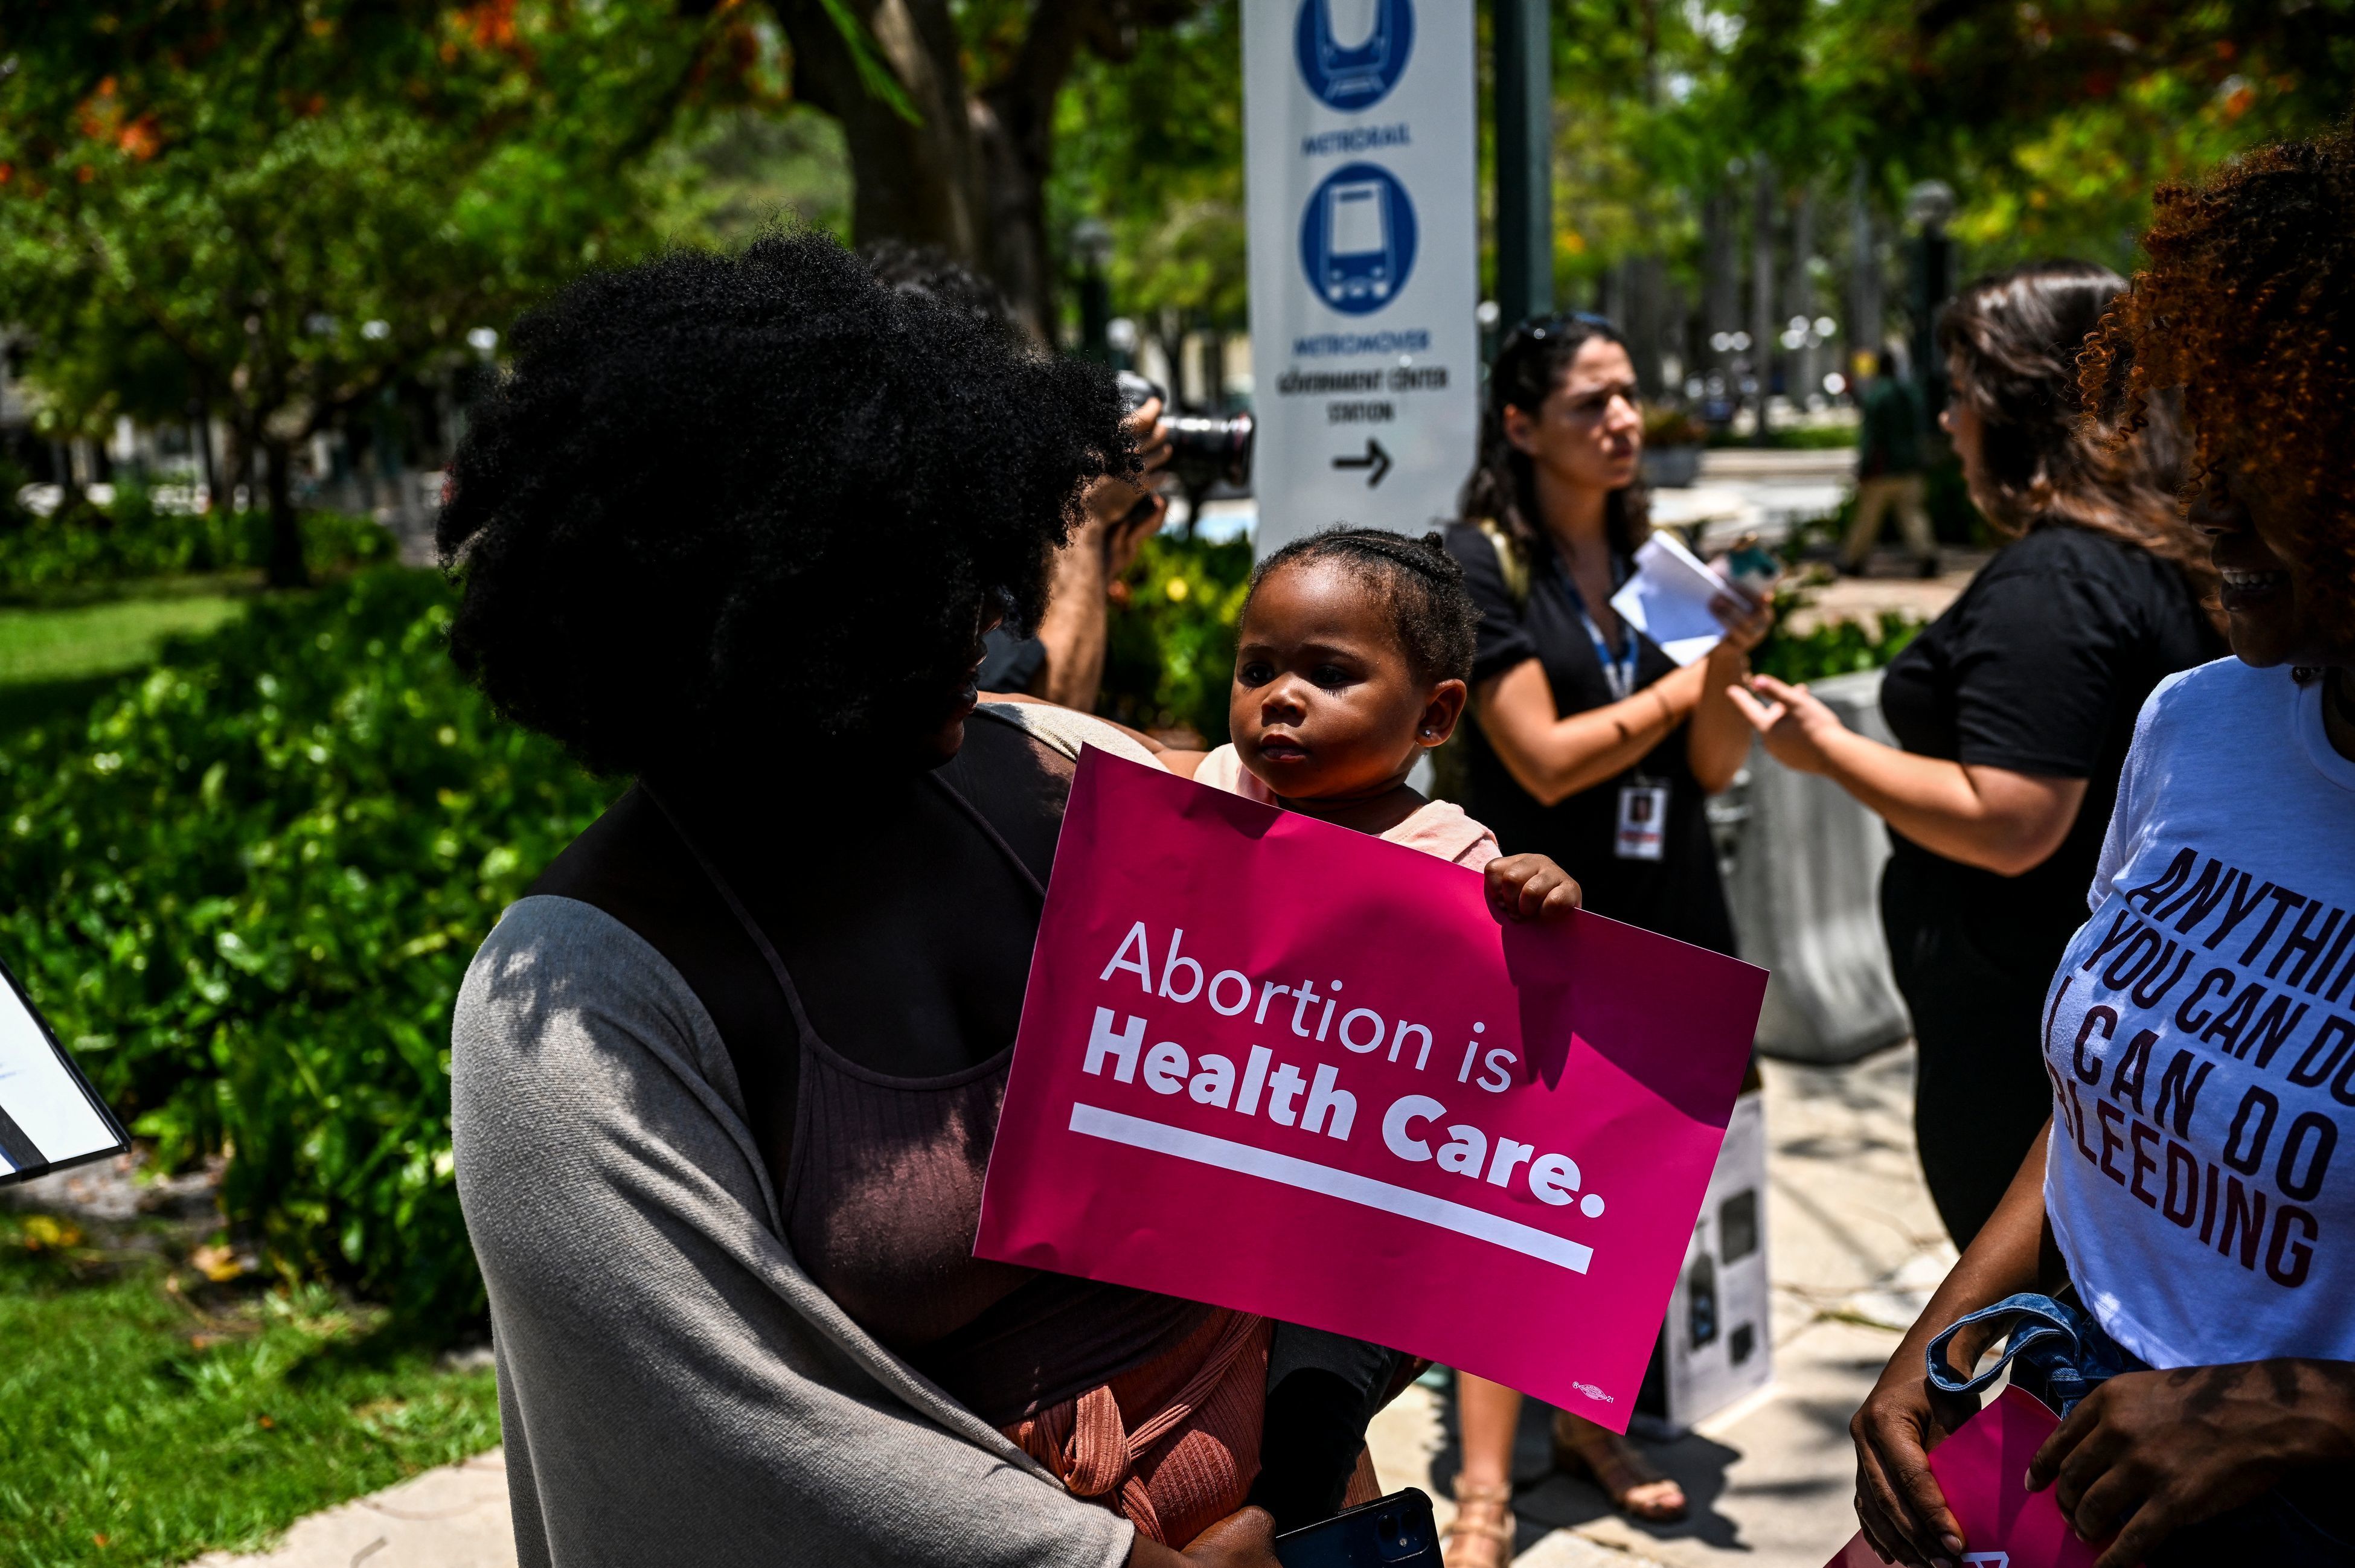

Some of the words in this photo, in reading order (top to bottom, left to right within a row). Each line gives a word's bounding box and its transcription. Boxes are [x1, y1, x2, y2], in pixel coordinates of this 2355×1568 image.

[1276, 371, 1381, 395] GOVERNMENT
[1389, 366, 1447, 391] CENTER
[1293, 330, 1429, 355] METROMOVER
[1328, 402, 1394, 422] STATION
[1100, 921, 1432, 1070] Abortion
[1458, 1022, 1517, 1092] is
[2083, 909, 2194, 1009] YOU
[2176, 968, 2310, 1069] CAN
[1083, 1006, 1357, 1141] Health
[1382, 1095, 1604, 1218] Care.
[2045, 975, 2073, 1054] I
[2073, 1005, 2215, 1141] CAN
[2223, 1085, 2337, 1202] DO
